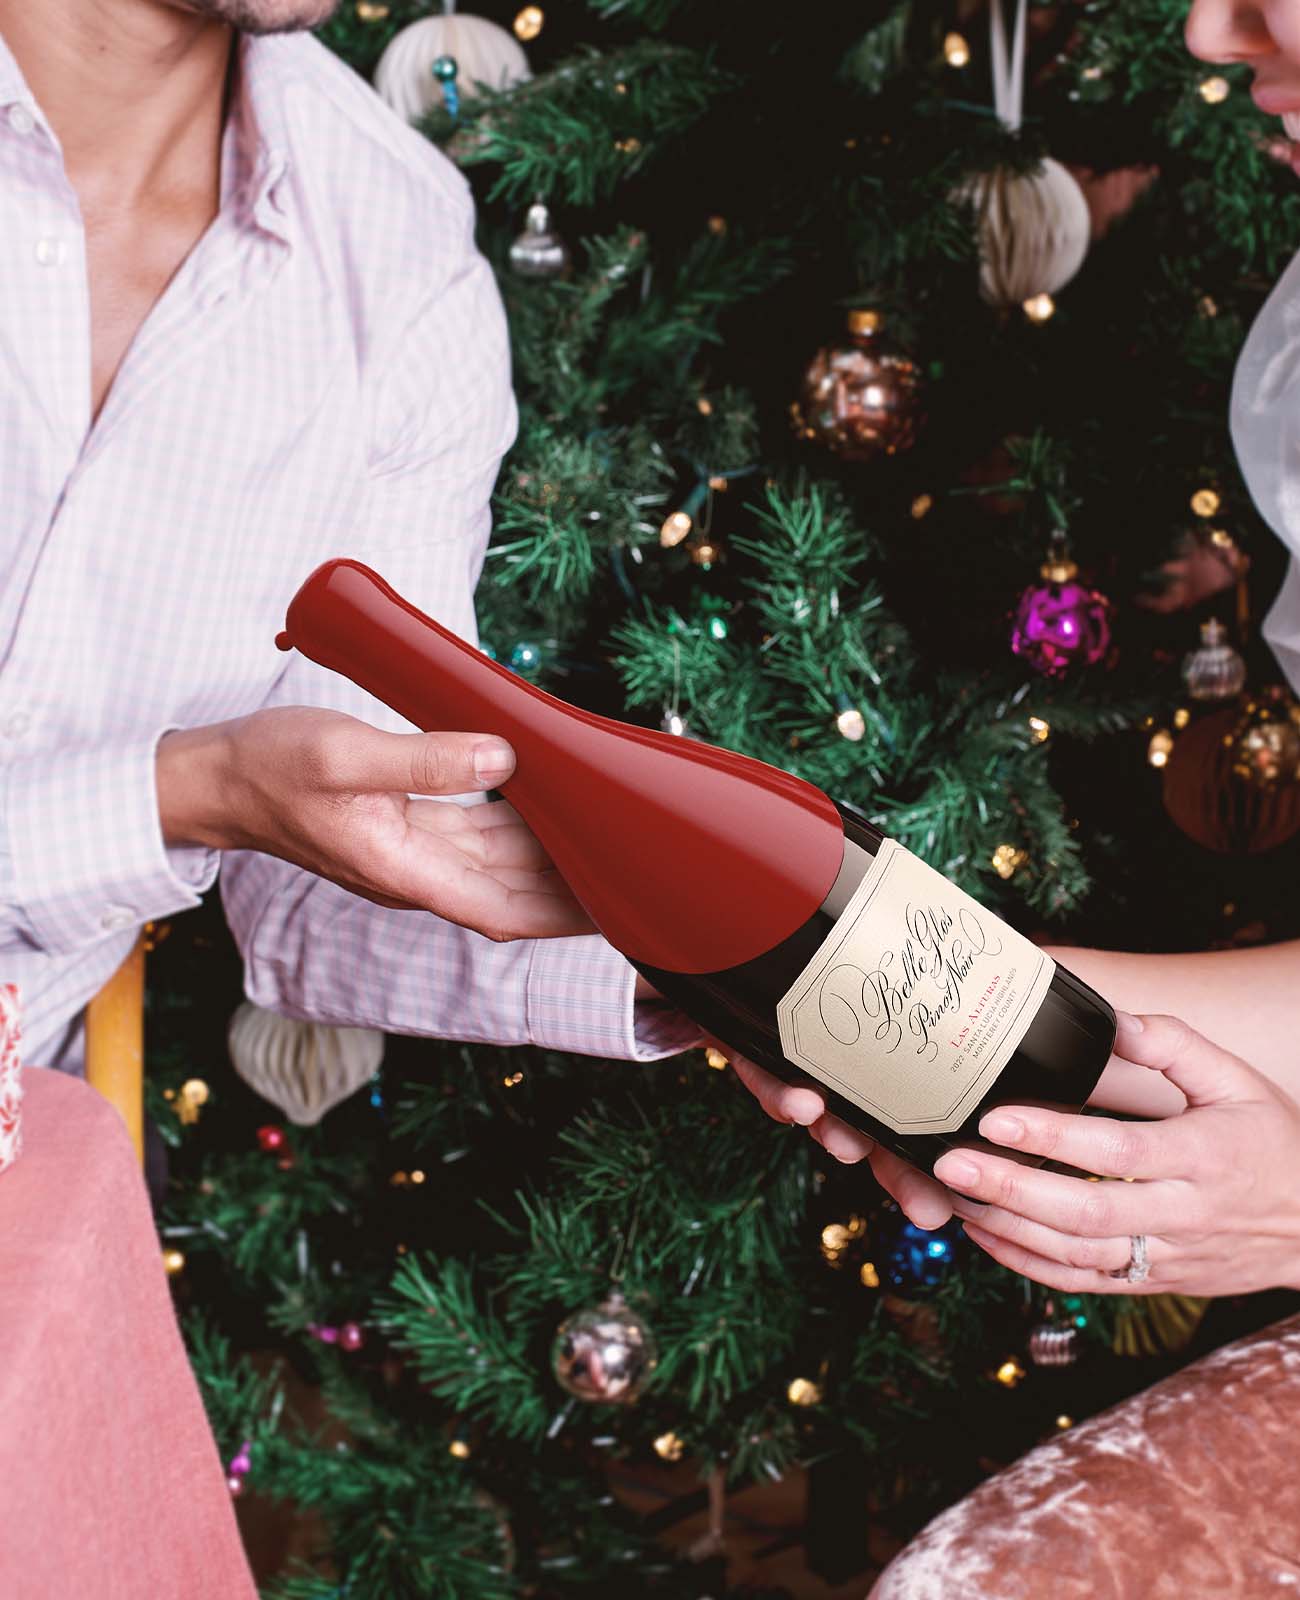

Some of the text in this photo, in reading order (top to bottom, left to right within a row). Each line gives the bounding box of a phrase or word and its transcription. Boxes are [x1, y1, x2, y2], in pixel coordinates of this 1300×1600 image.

[819, 902, 953, 1054] Belle Glos
[908, 908, 1003, 1063] Pinot Noir
[951, 975, 1001, 1048] LAS ALTURAS
[963, 1027, 983, 1054] SANTA
[981, 1006, 997, 1029] LUCIA
[994, 967, 1017, 1005] HIGHLANDS
[972, 990, 1017, 1059] MONTEREY COUNTY
